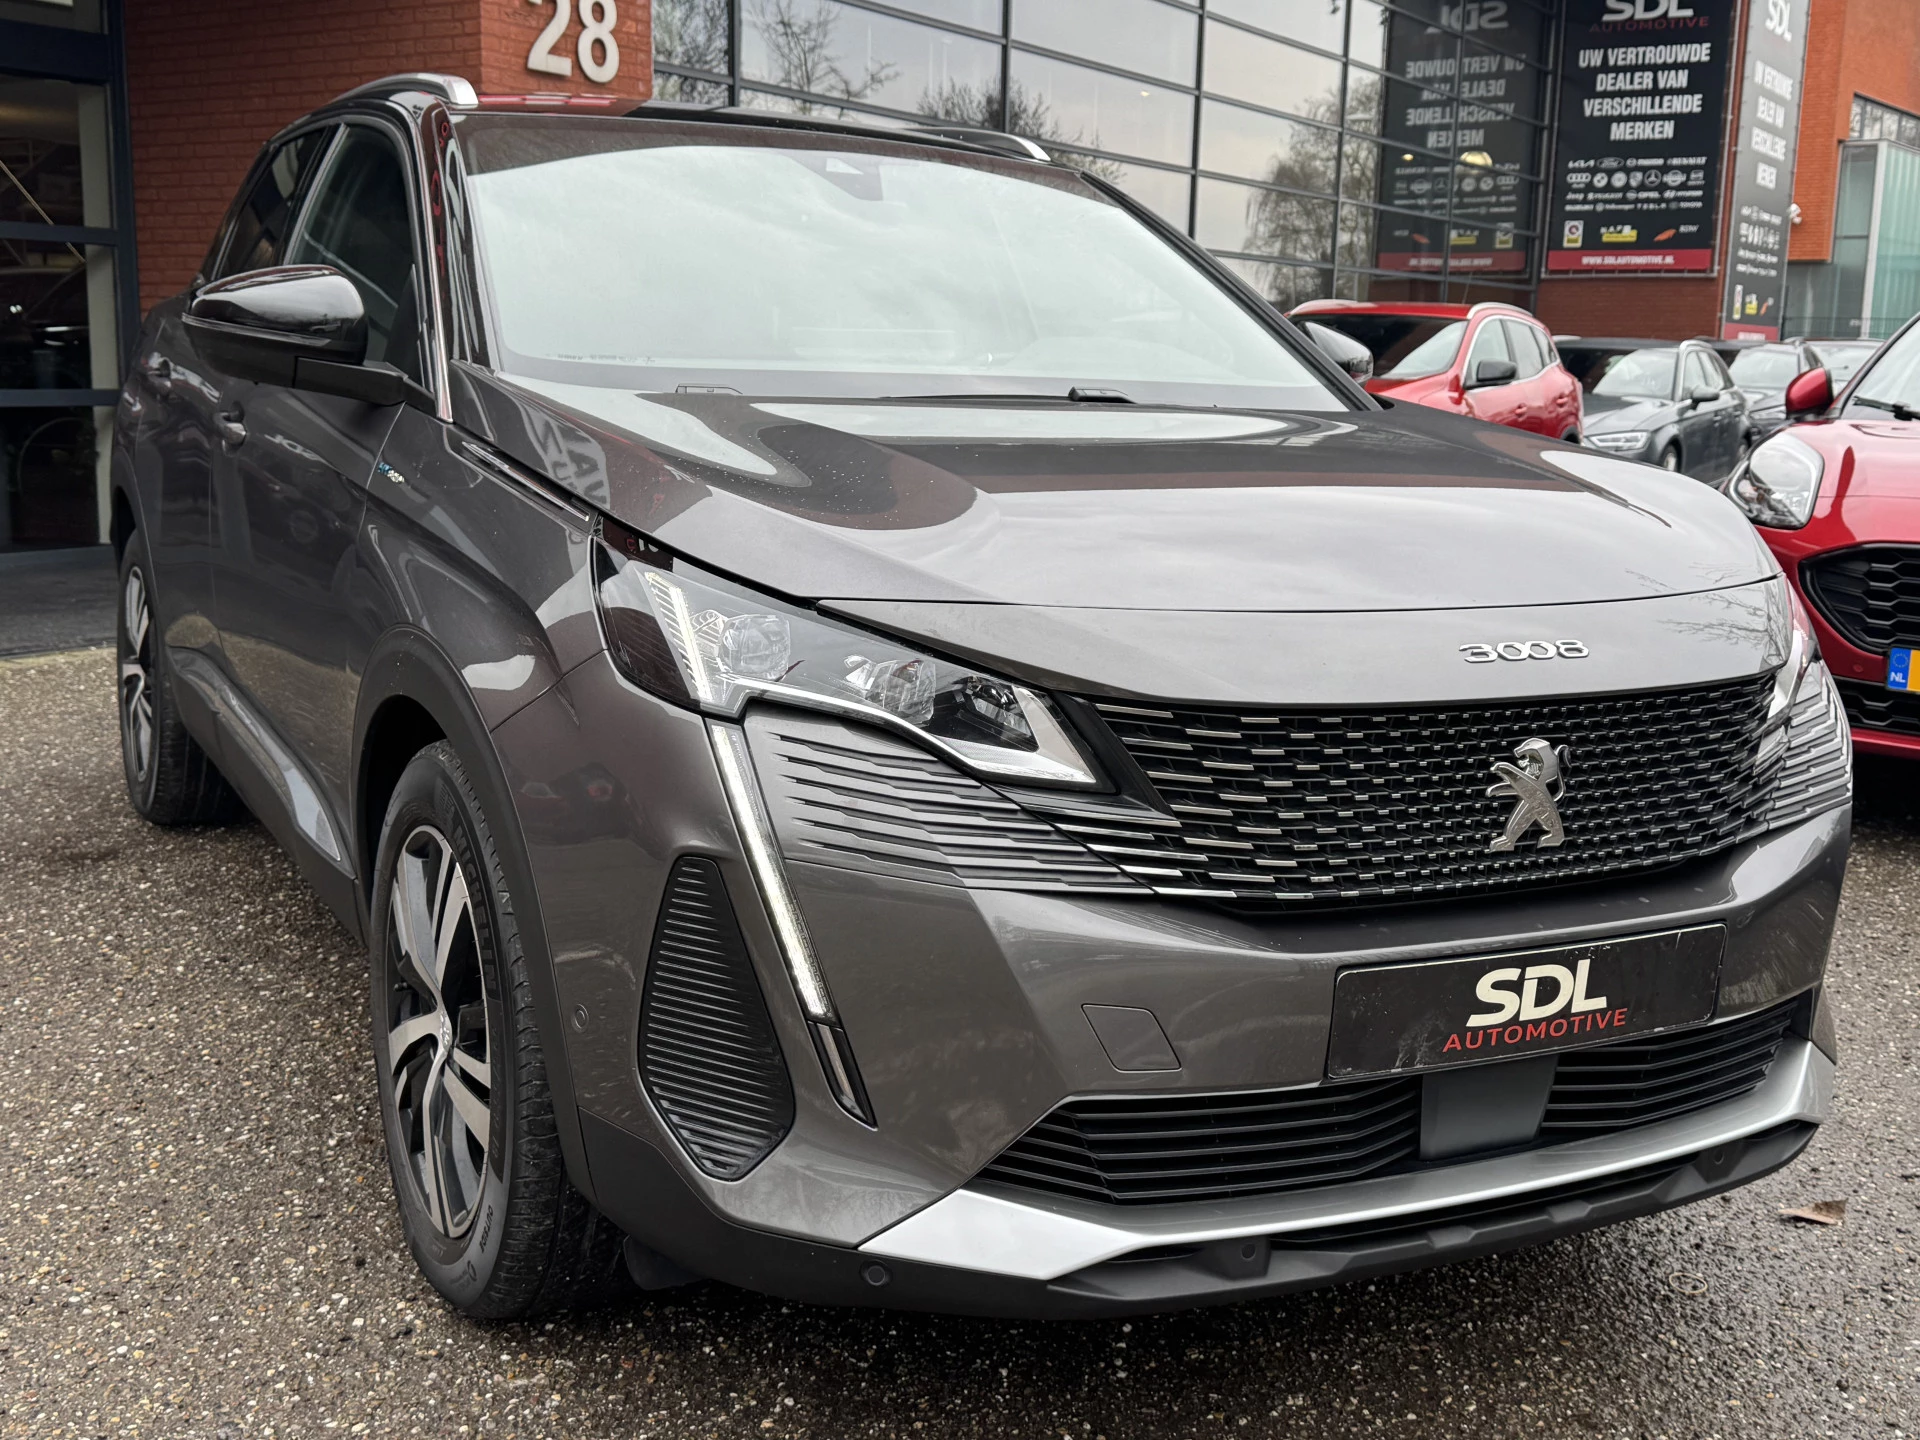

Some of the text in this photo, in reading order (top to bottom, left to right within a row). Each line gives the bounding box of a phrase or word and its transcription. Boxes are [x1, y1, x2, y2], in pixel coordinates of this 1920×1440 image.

[1589, 16, 1710, 33] AUTOMOTIVE
[527, 0, 619, 83] 28
[1578, 43, 1711, 68] UW VERTROUWDE
[1595, 69, 1689, 92] DEALER VAN
[1583, 94, 1703, 117] VERSCHILLENDE
[1610, 120, 1675, 141] MERKEN
[1459, 639, 1589, 663] 3008
[1890, 671, 1906, 683] NL
[1466, 958, 1607, 1027] SDL
[1442, 1008, 1628, 1053] AUTOMOTIVE
